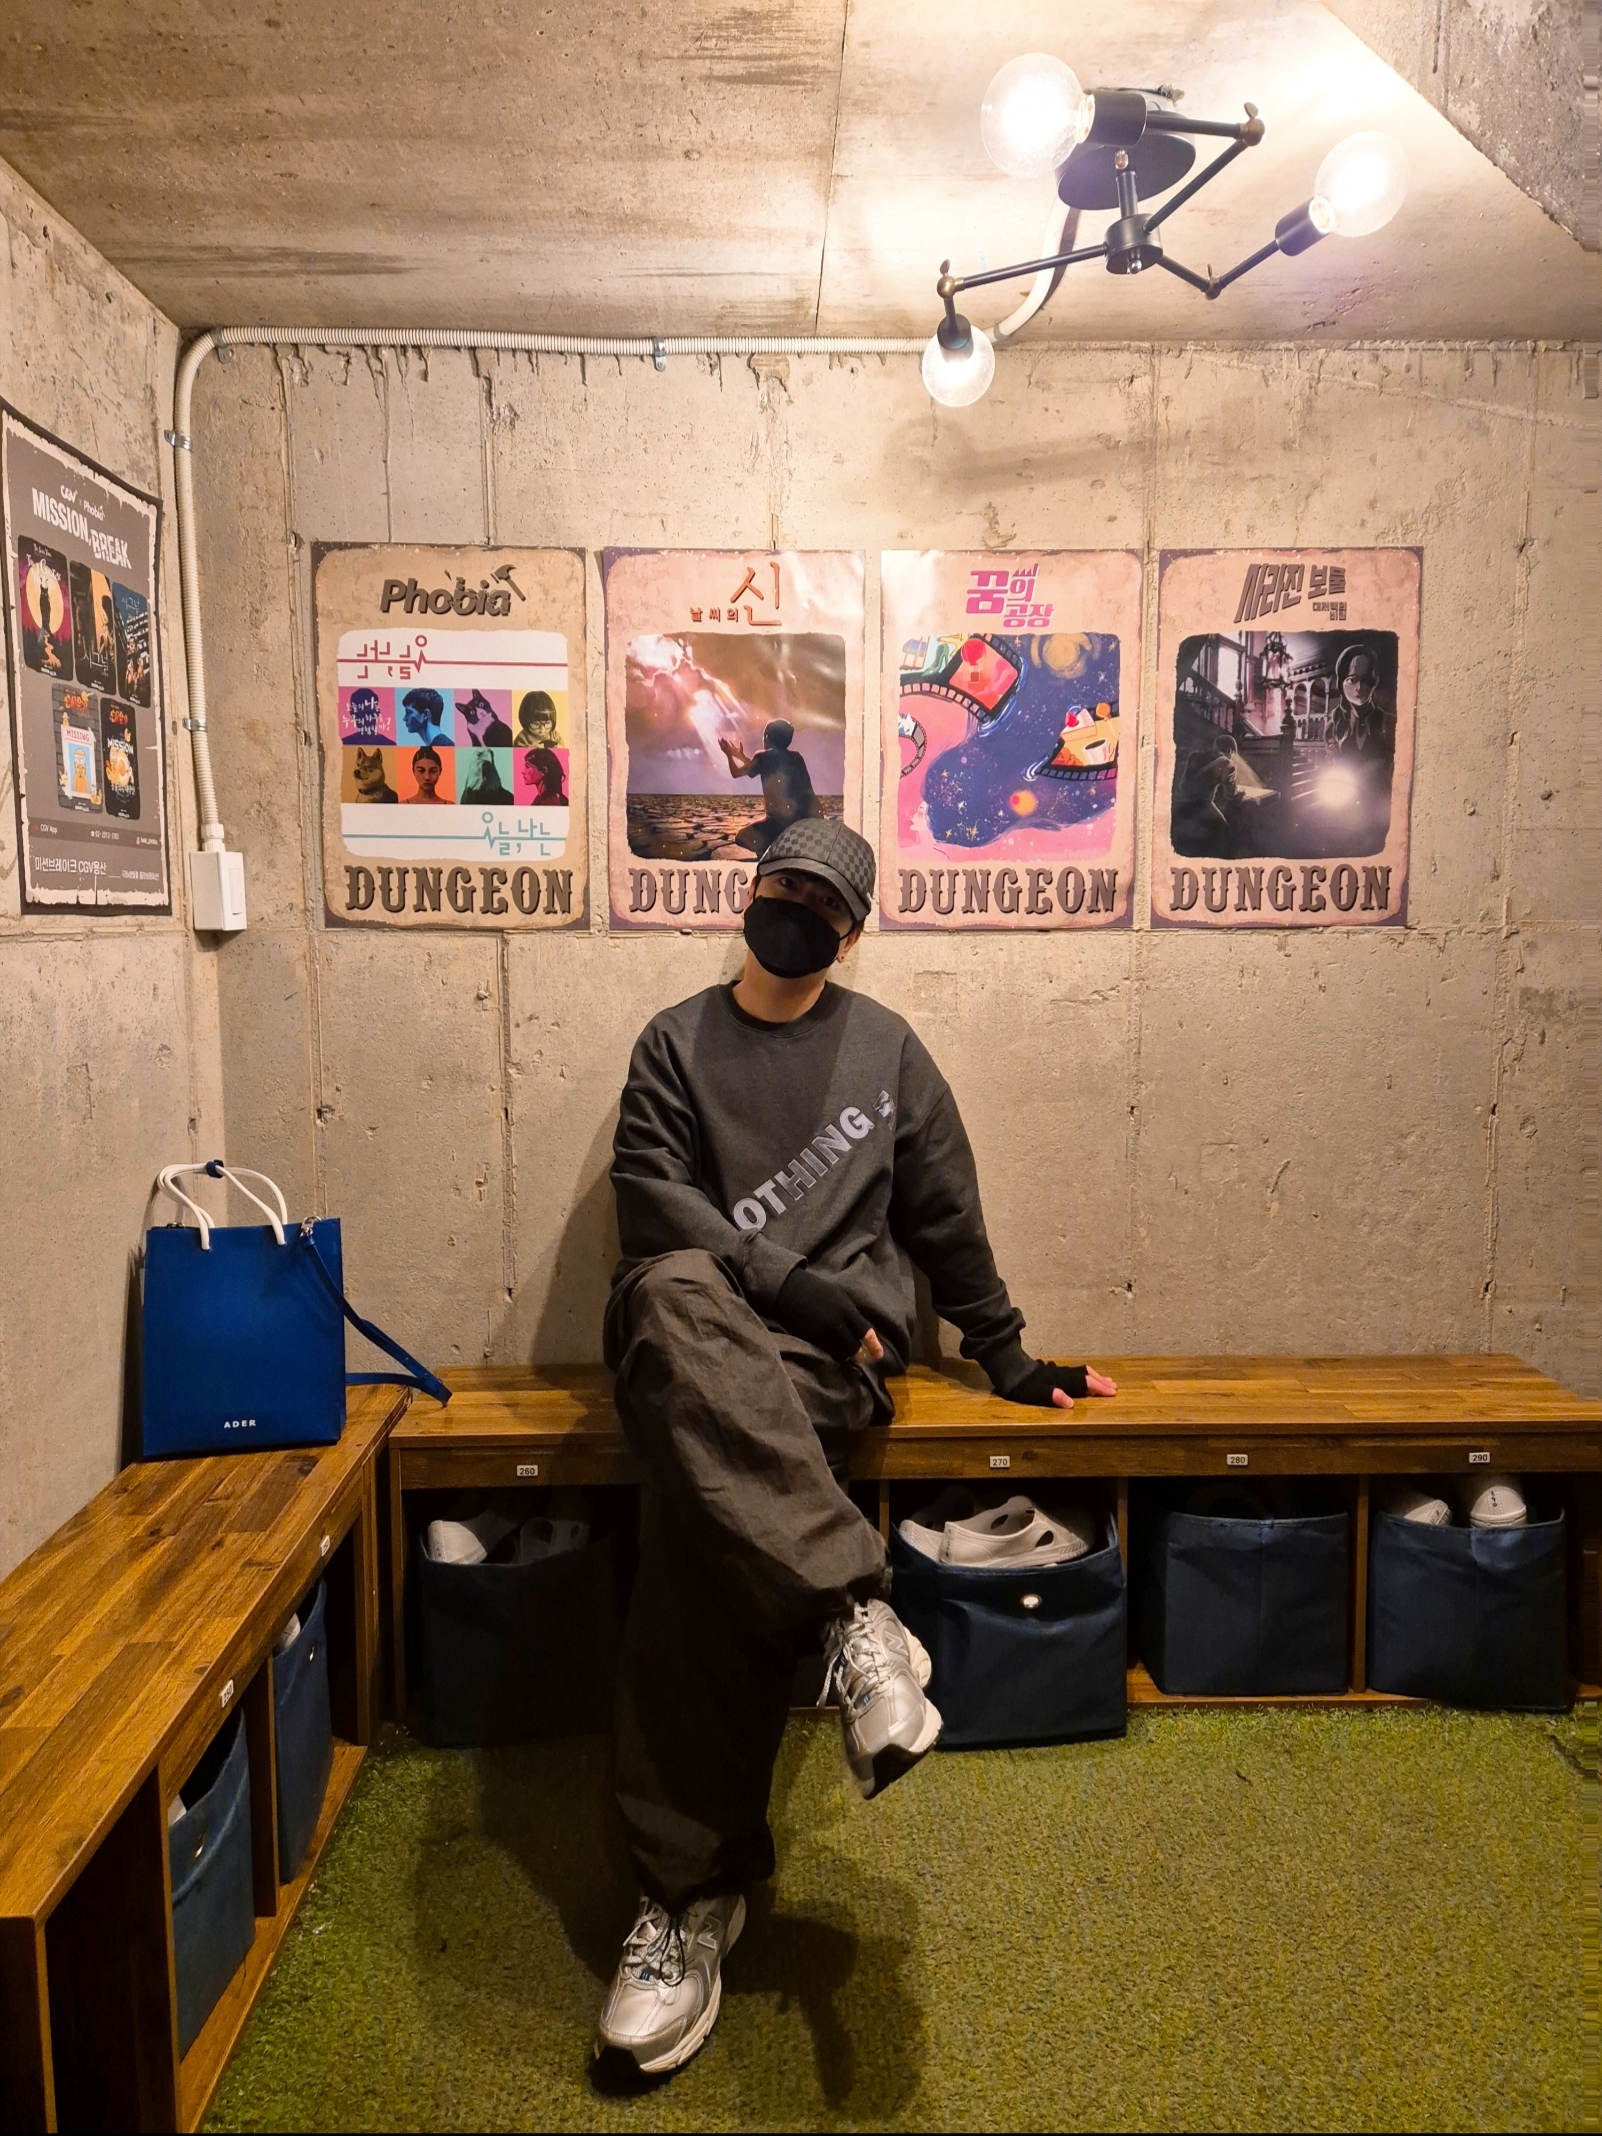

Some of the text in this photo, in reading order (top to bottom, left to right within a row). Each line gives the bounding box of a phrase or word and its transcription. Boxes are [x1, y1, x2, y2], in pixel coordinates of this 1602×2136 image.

[60, 485, 76, 504] CGV
[90, 529, 132, 570] BREAK
[379, 576, 513, 617] Phobia
[689, 561, 782, 626] 날씨의 신
[965, 563, 1039, 614] 꿈의
[1233, 563, 1347, 624] 사라진 보물
[1003, 603, 1055, 628] 공장
[66, 729, 90, 742] MISSING
[107, 738, 134, 755] MISSION
[35, 856, 77, 873] 미션브레이크
[344, 864, 574, 915] DUNGEON
[628, 867, 751, 915] DUNG
[897, 865, 1118, 915] DUNGEON
[1169, 863, 1393, 913] DUNGEON
[223, 1419, 257, 1429] ADER
[992, 1458, 1008, 1466] 270
[1230, 1455, 1246, 1464] 280
[1472, 1453, 1488, 1462] 290
[519, 1467, 536, 1475] 260
